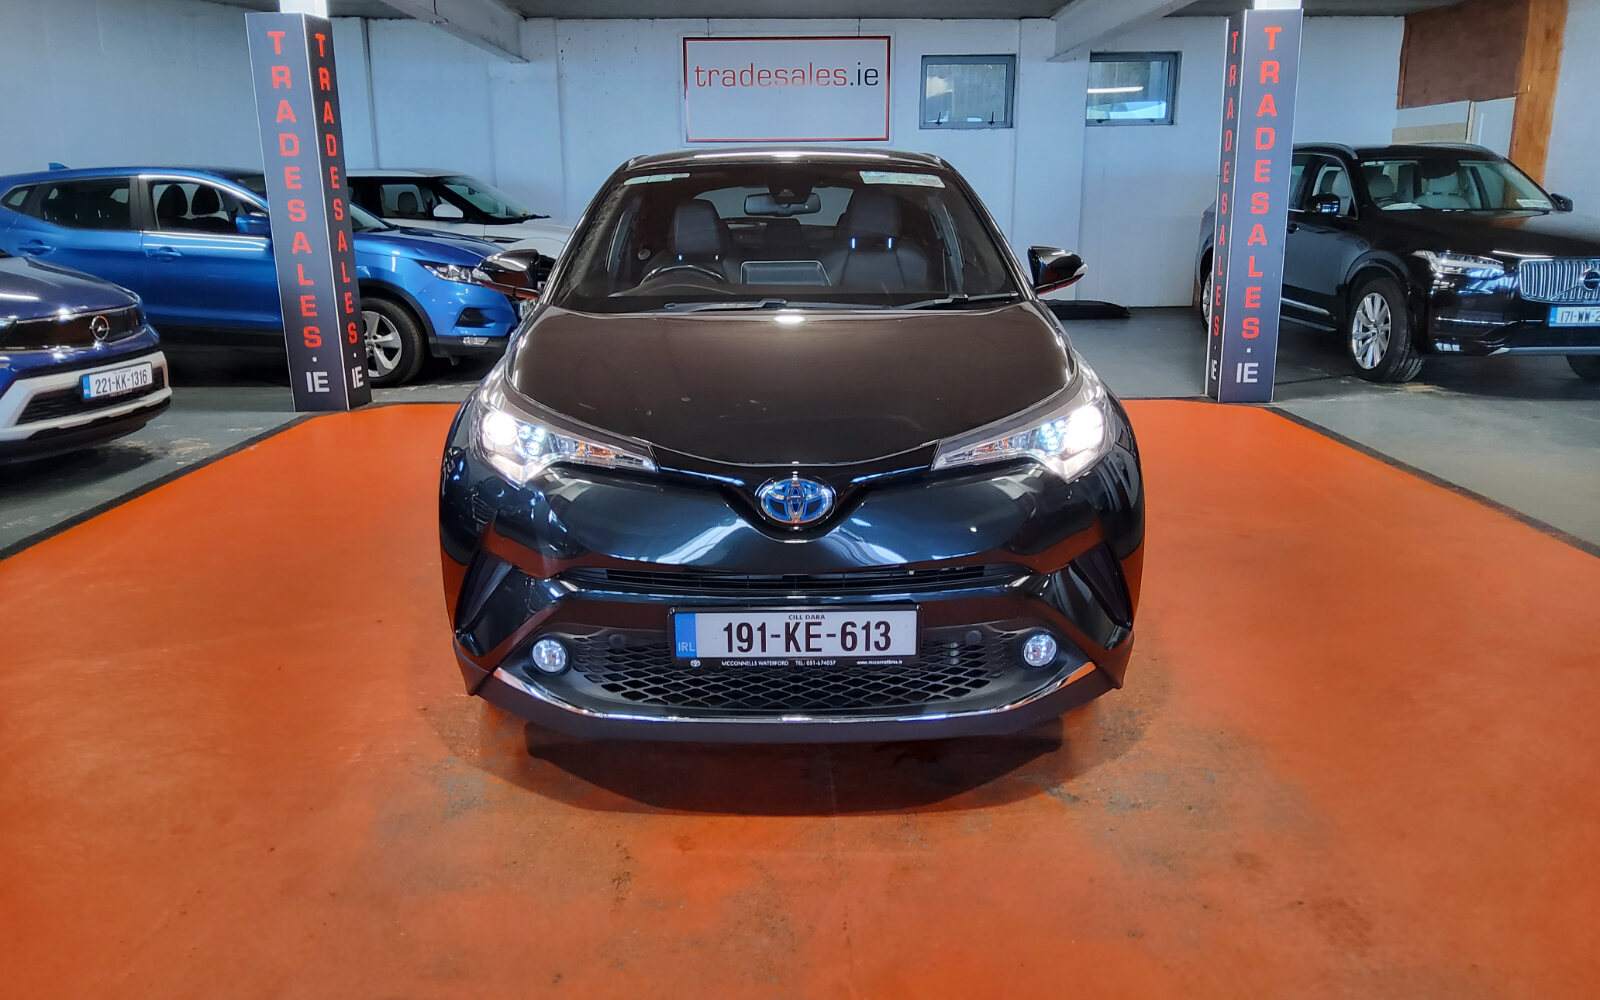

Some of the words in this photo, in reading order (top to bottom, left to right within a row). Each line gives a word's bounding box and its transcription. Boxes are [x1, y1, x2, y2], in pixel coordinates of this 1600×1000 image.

[694, 62, 879, 87] tradesales.ie
[95, 369, 148, 394] 221-KK-1316
[678, 641, 696, 652] IRL
[723, 621, 891, 653] 191-KE-613
